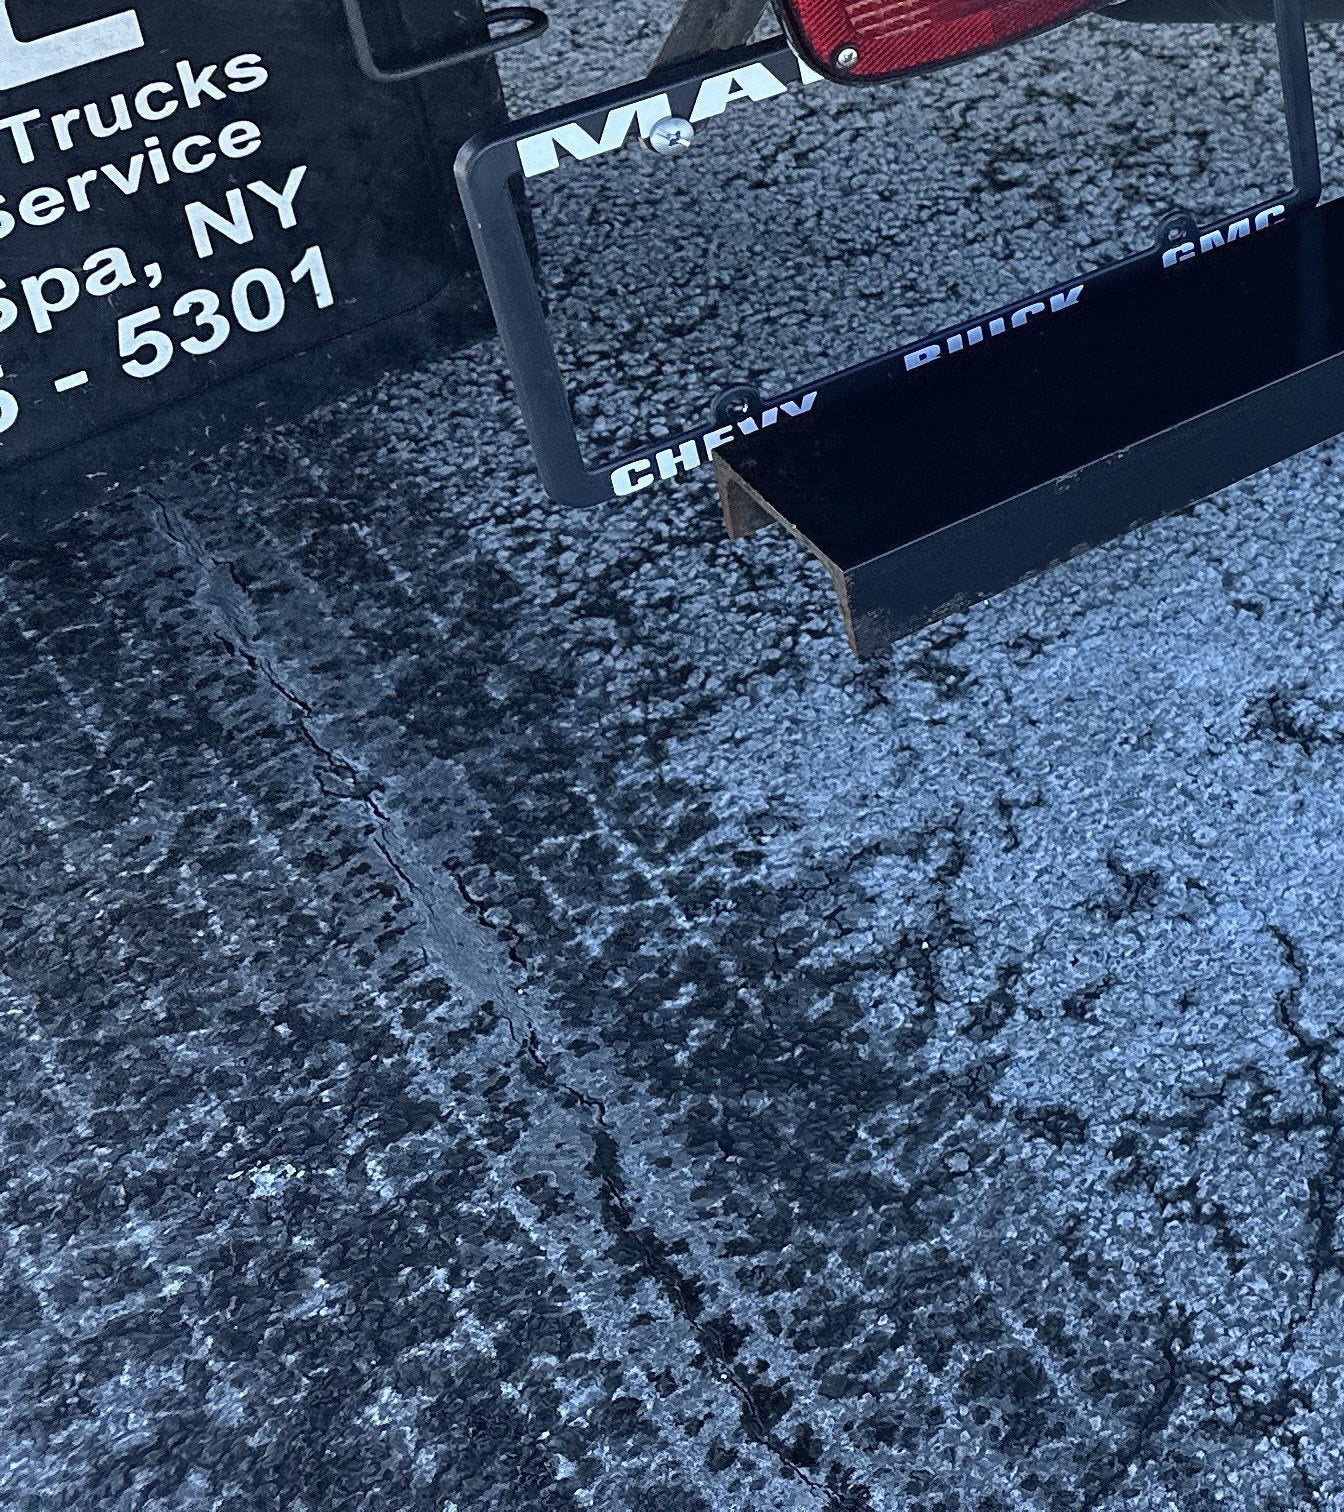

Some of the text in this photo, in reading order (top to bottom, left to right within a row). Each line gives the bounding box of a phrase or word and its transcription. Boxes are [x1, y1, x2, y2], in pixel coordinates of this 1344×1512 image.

[0, 53, 268, 164] Trucks
[184, 165, 307, 258] NY
[117, 244, 334, 378] 5301
